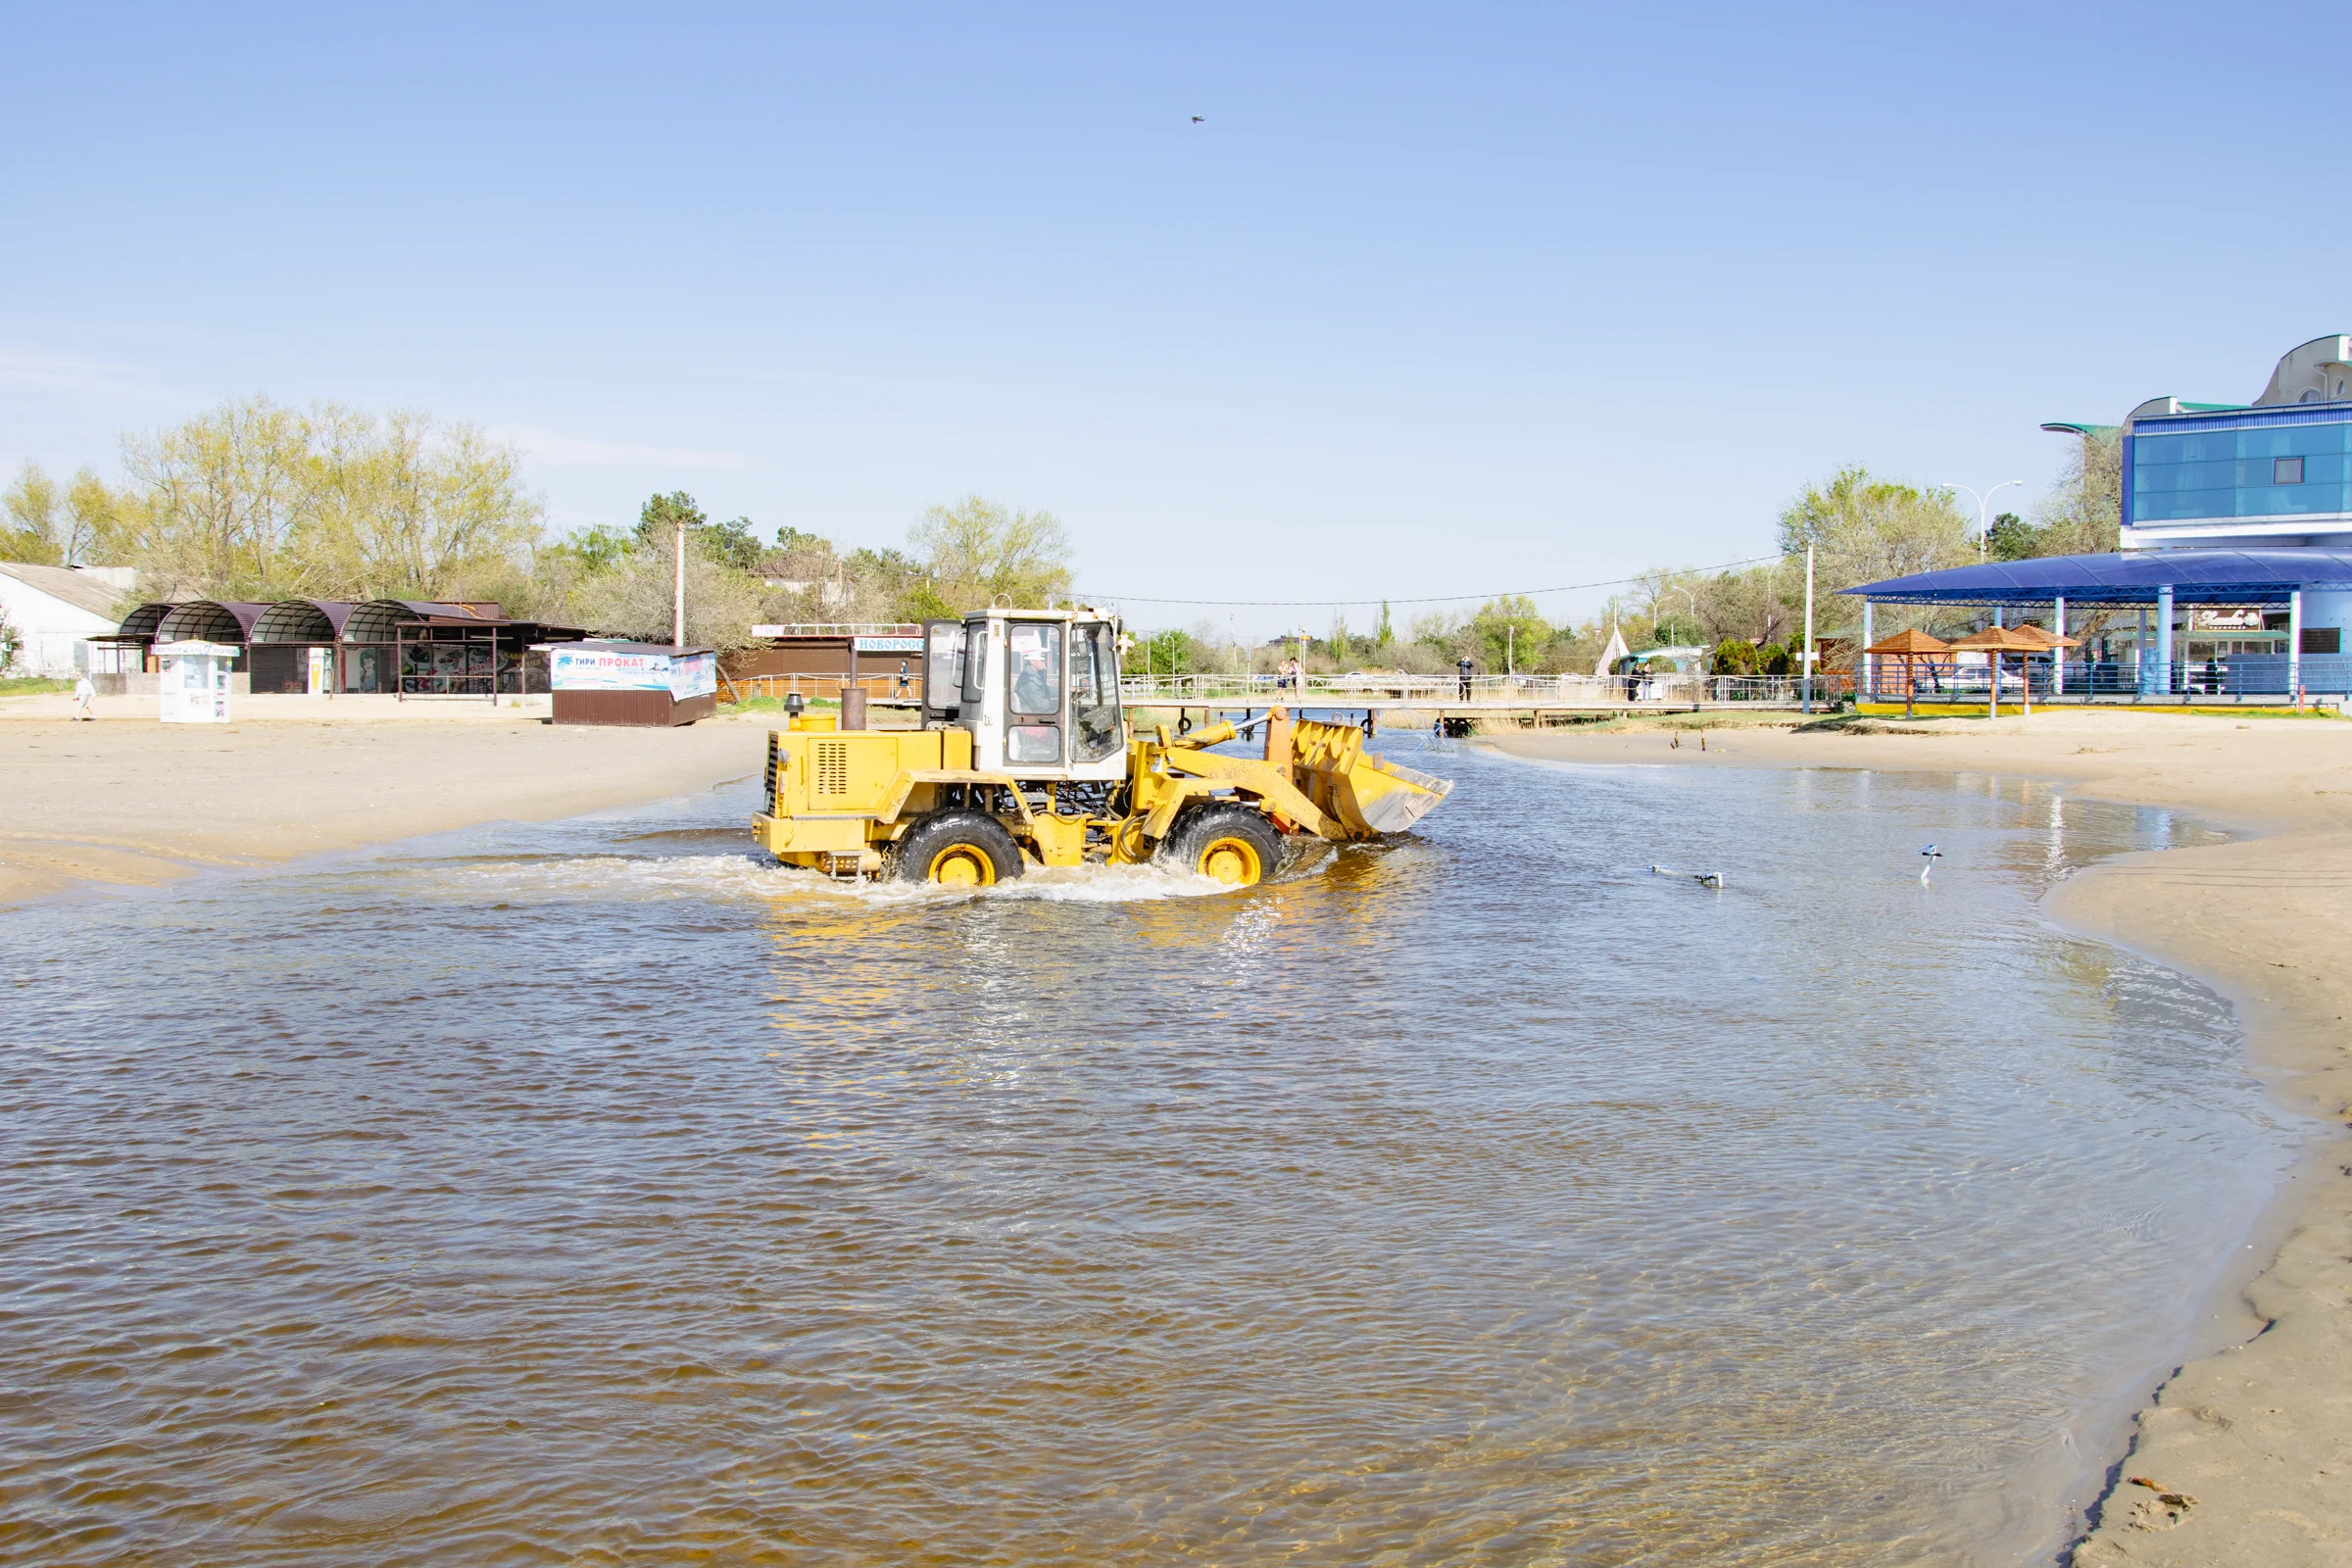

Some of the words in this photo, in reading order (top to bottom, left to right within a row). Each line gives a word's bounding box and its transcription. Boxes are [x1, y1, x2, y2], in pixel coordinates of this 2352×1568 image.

[515, 660, 541, 668] КХНЯ
[599, 658, 645, 667] ПРОКАТ
[459, 663, 485, 672] БЮДА
